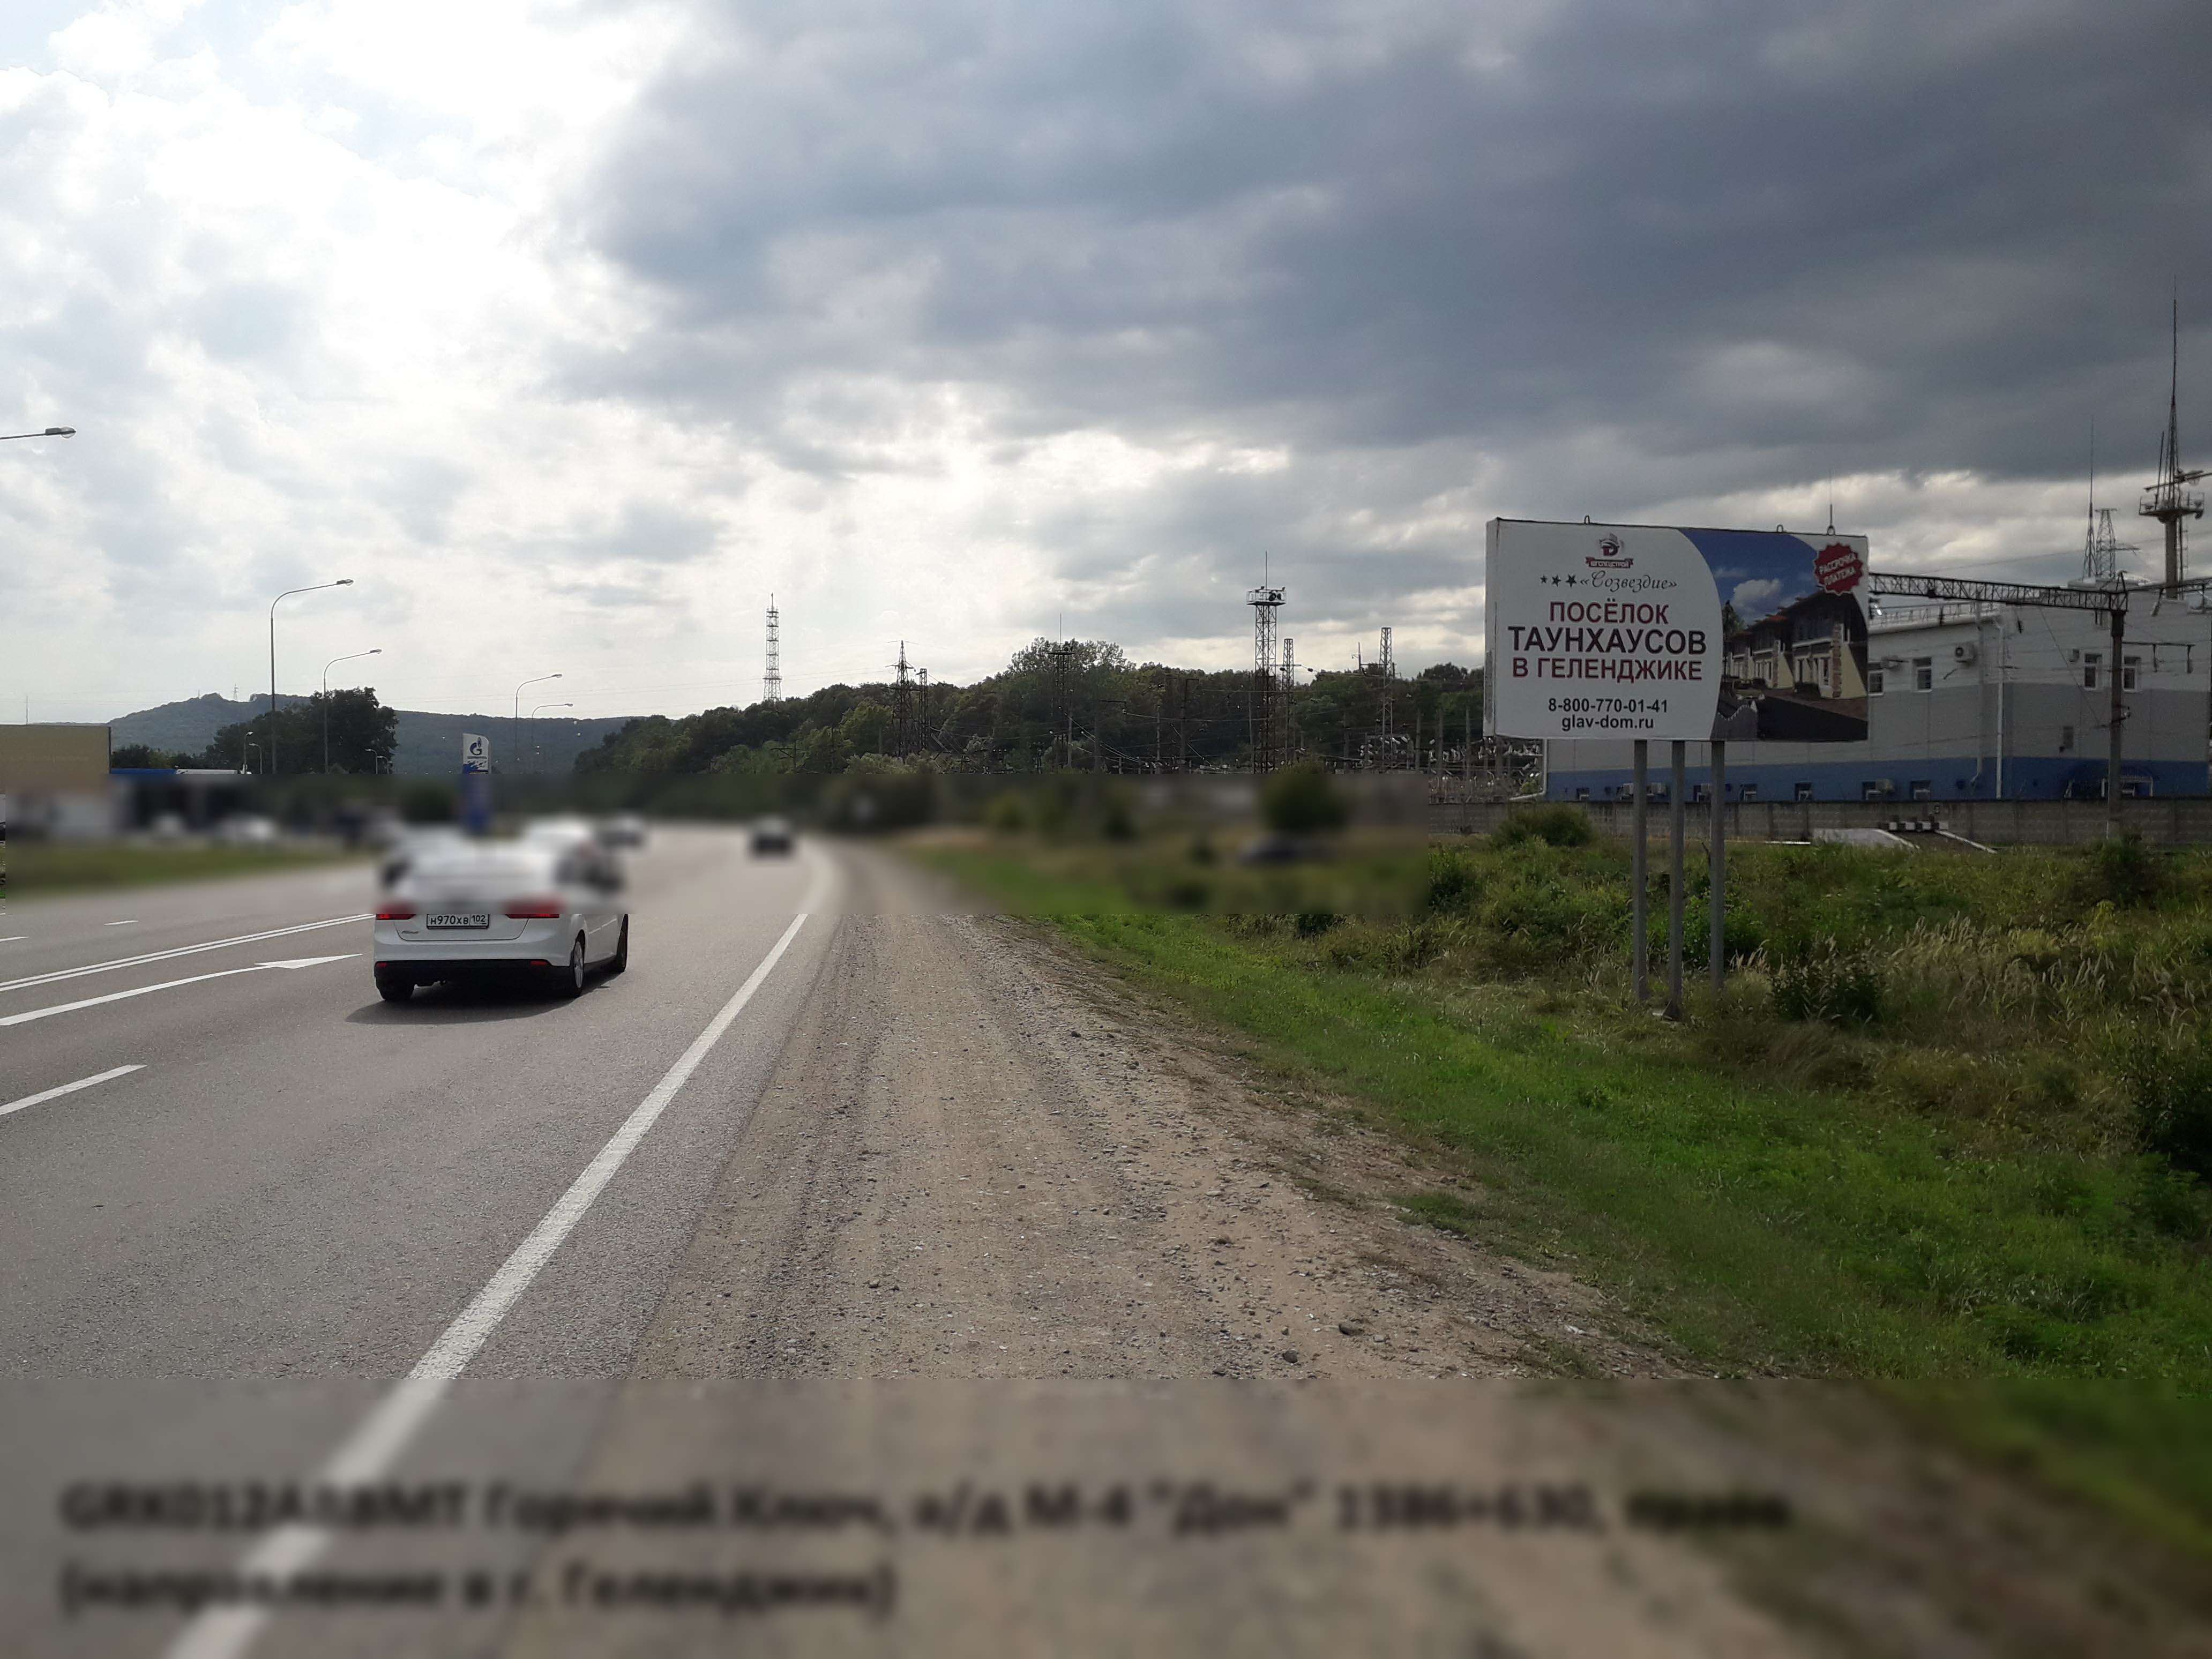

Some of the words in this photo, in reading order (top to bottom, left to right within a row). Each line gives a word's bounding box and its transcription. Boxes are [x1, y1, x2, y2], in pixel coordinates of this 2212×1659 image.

[1550, 597, 1669, 625] ПОСЁЛОК
[1507, 626, 1707, 655] ТАУНХАУСОВ
[1513, 657, 1528, 678] В
[1537, 658, 1702, 684] ГЕЛЕНДЖИКЕ
[1548, 698, 1668, 713] 8-800-770-01-41
[1561, 714, 1654, 731] glav-dom.ru
